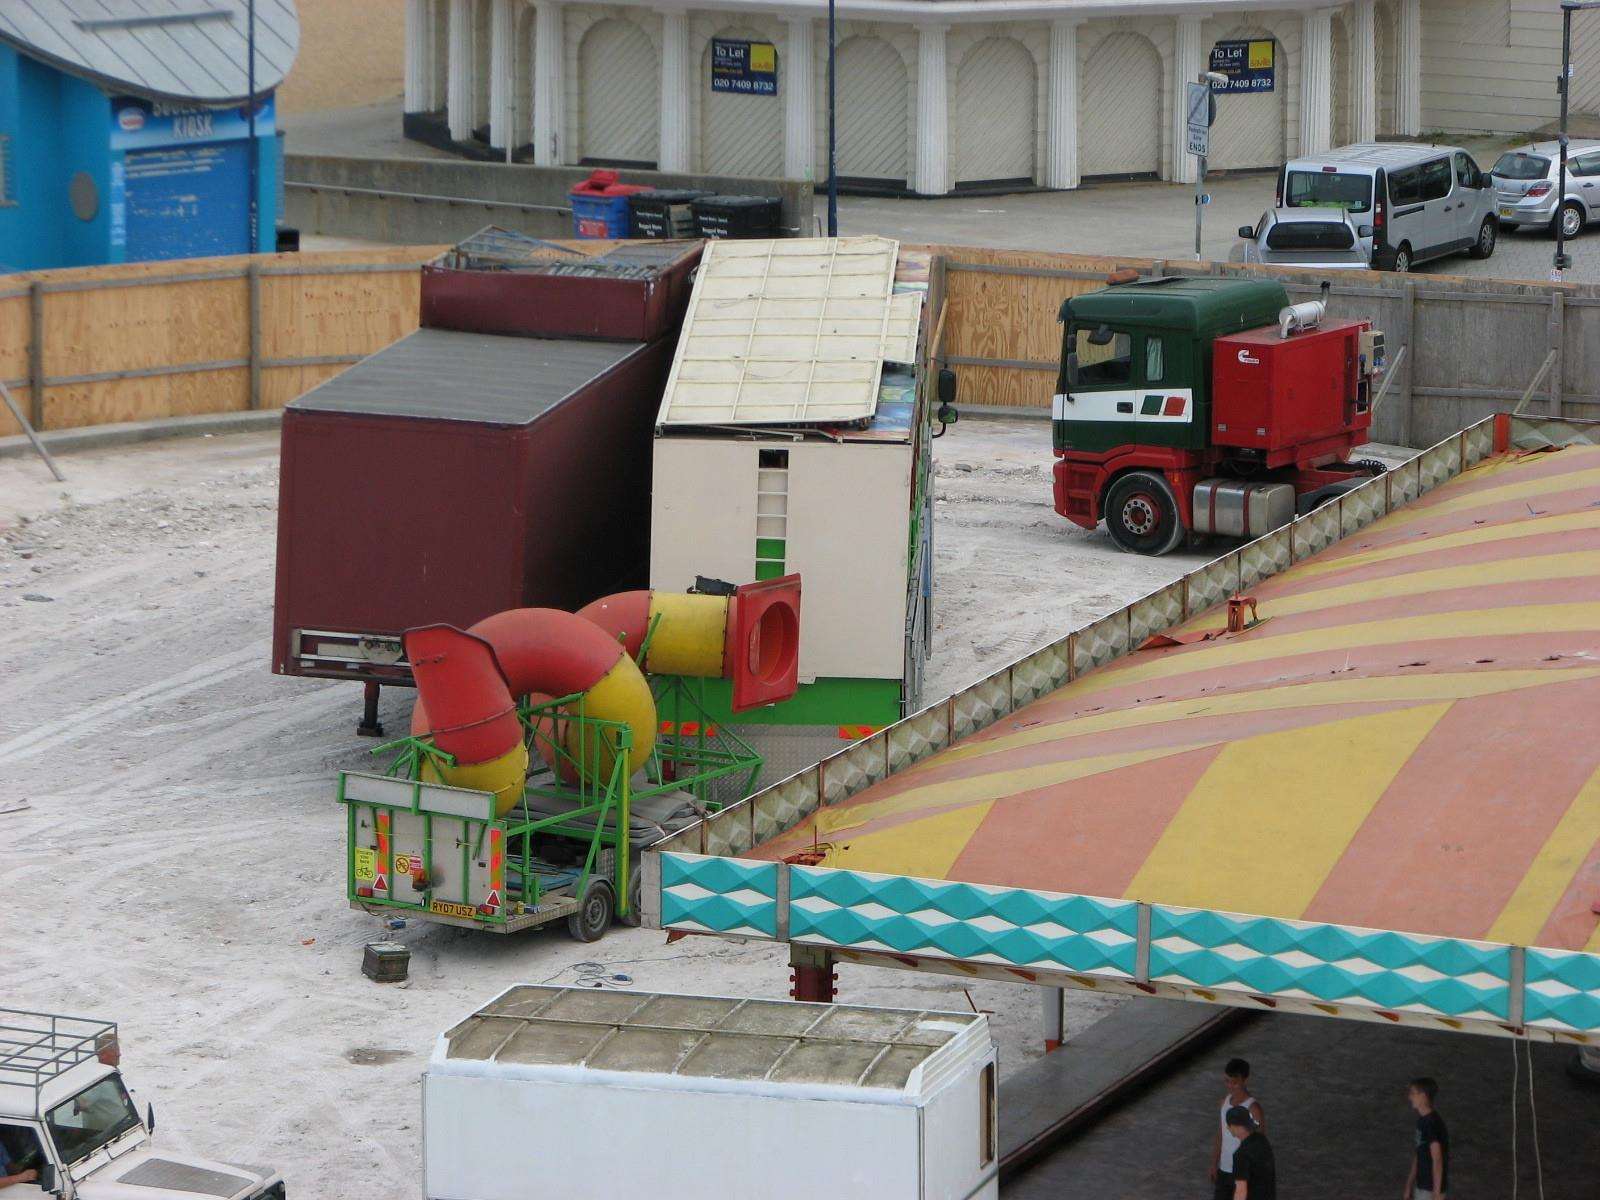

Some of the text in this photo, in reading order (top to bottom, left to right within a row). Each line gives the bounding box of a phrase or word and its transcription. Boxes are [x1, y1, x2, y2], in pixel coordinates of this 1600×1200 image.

[716, 47, 744, 58] To Let
[1213, 48, 1243, 59] To Let
[714, 79, 775, 91] 020 7409 8732
[1230, 80, 1250, 88] 7409
[1251, 79, 1272, 88] 8732
[173, 114, 214, 138] KIOSK
[1189, 142, 1206, 153] ENDS
[432, 902, 473, 917] RY07 USZ
